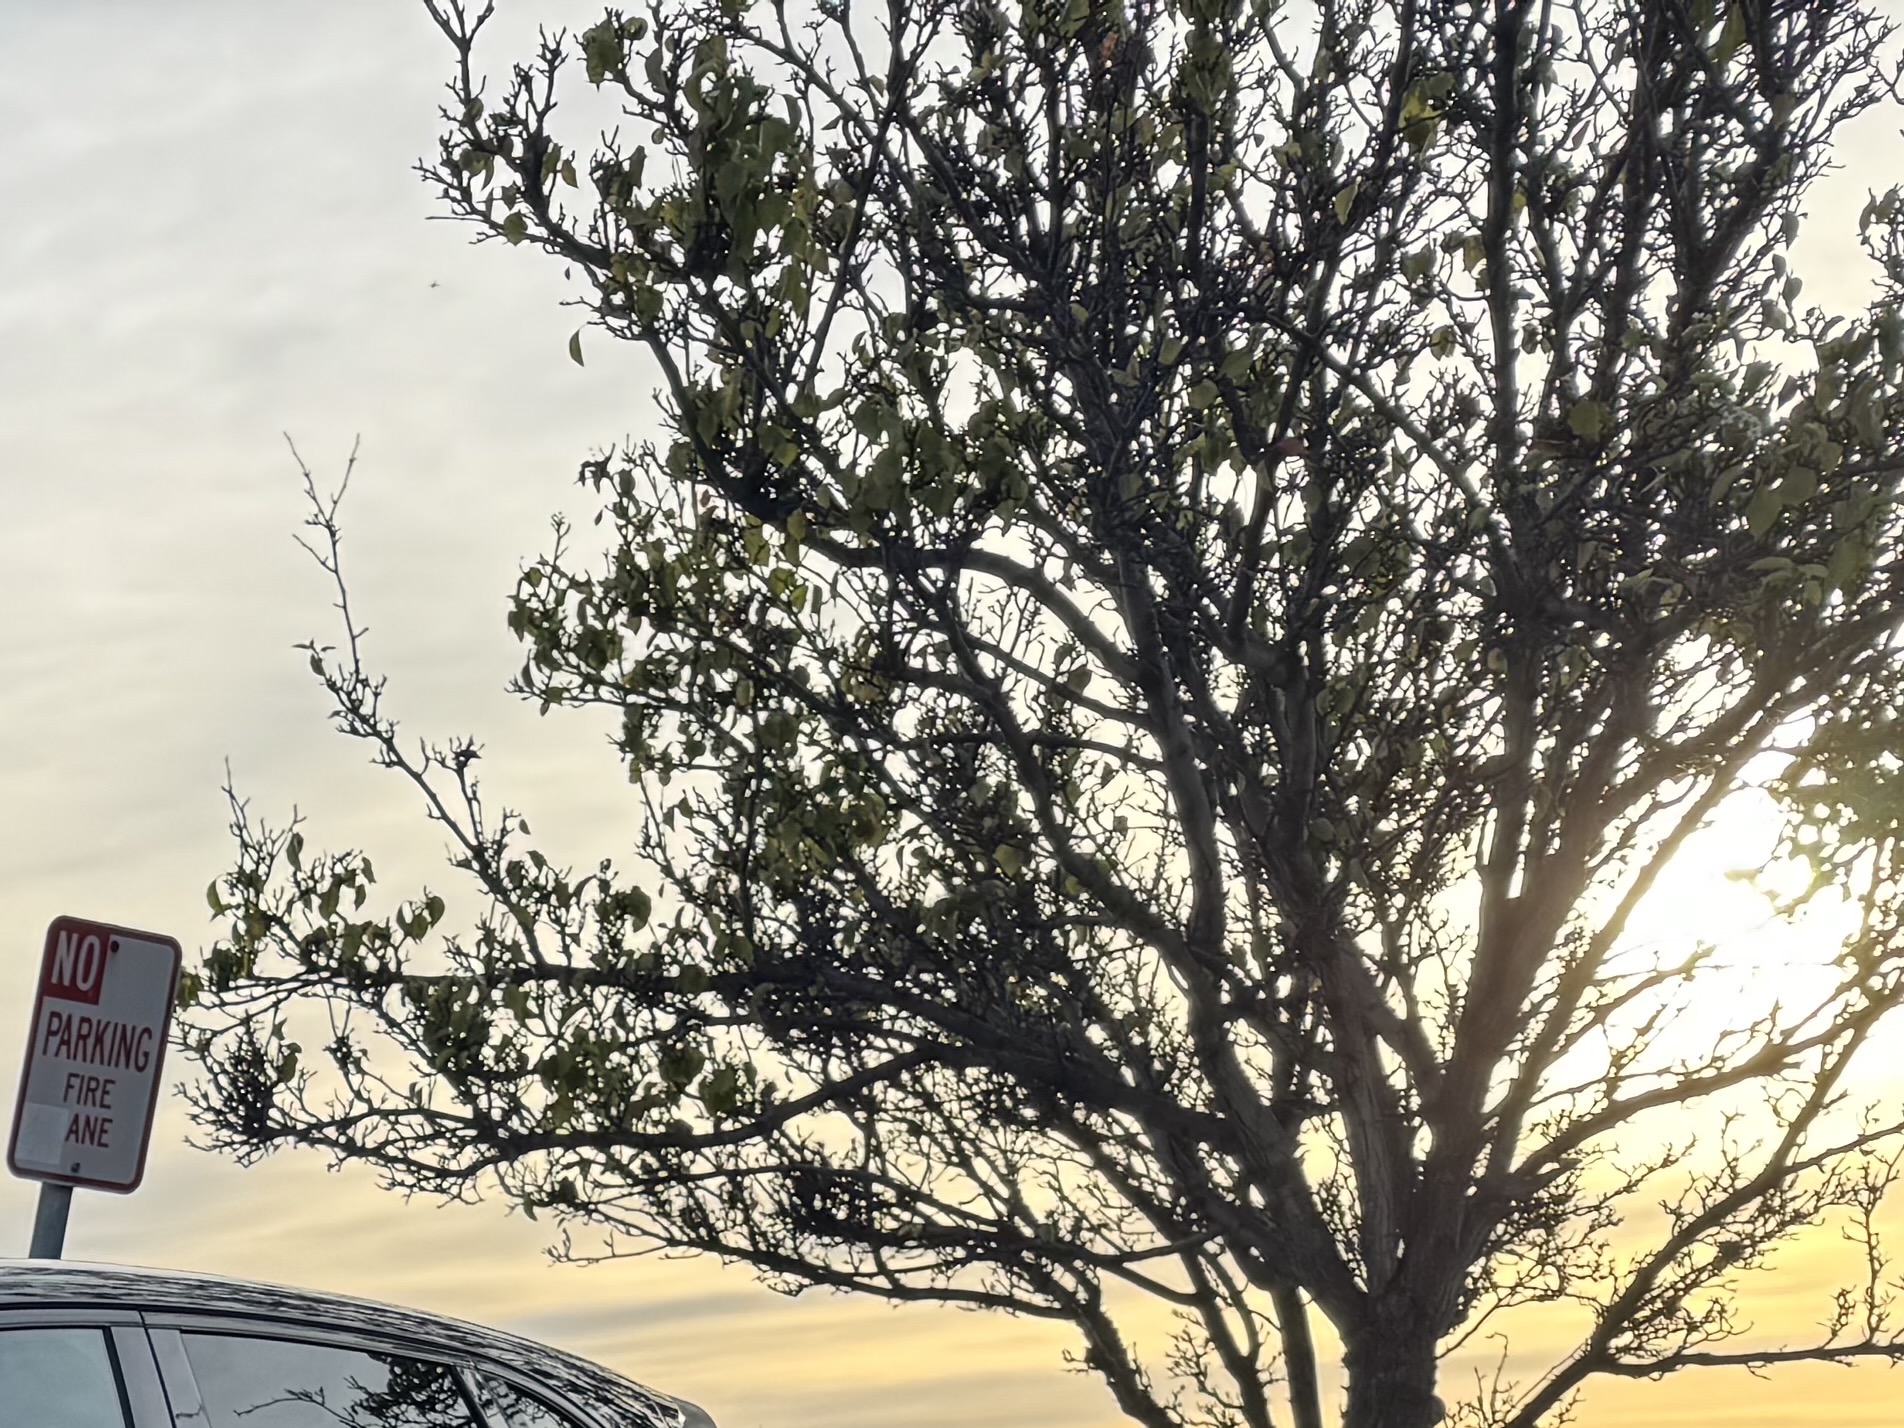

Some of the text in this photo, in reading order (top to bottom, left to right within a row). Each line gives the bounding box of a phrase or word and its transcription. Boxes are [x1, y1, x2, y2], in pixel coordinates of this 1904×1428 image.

[51, 930, 101, 992] NO
[43, 1011, 153, 1073] PARKING
[63, 1073, 116, 1109] FIRE
[65, 1113, 113, 1148] ANE
